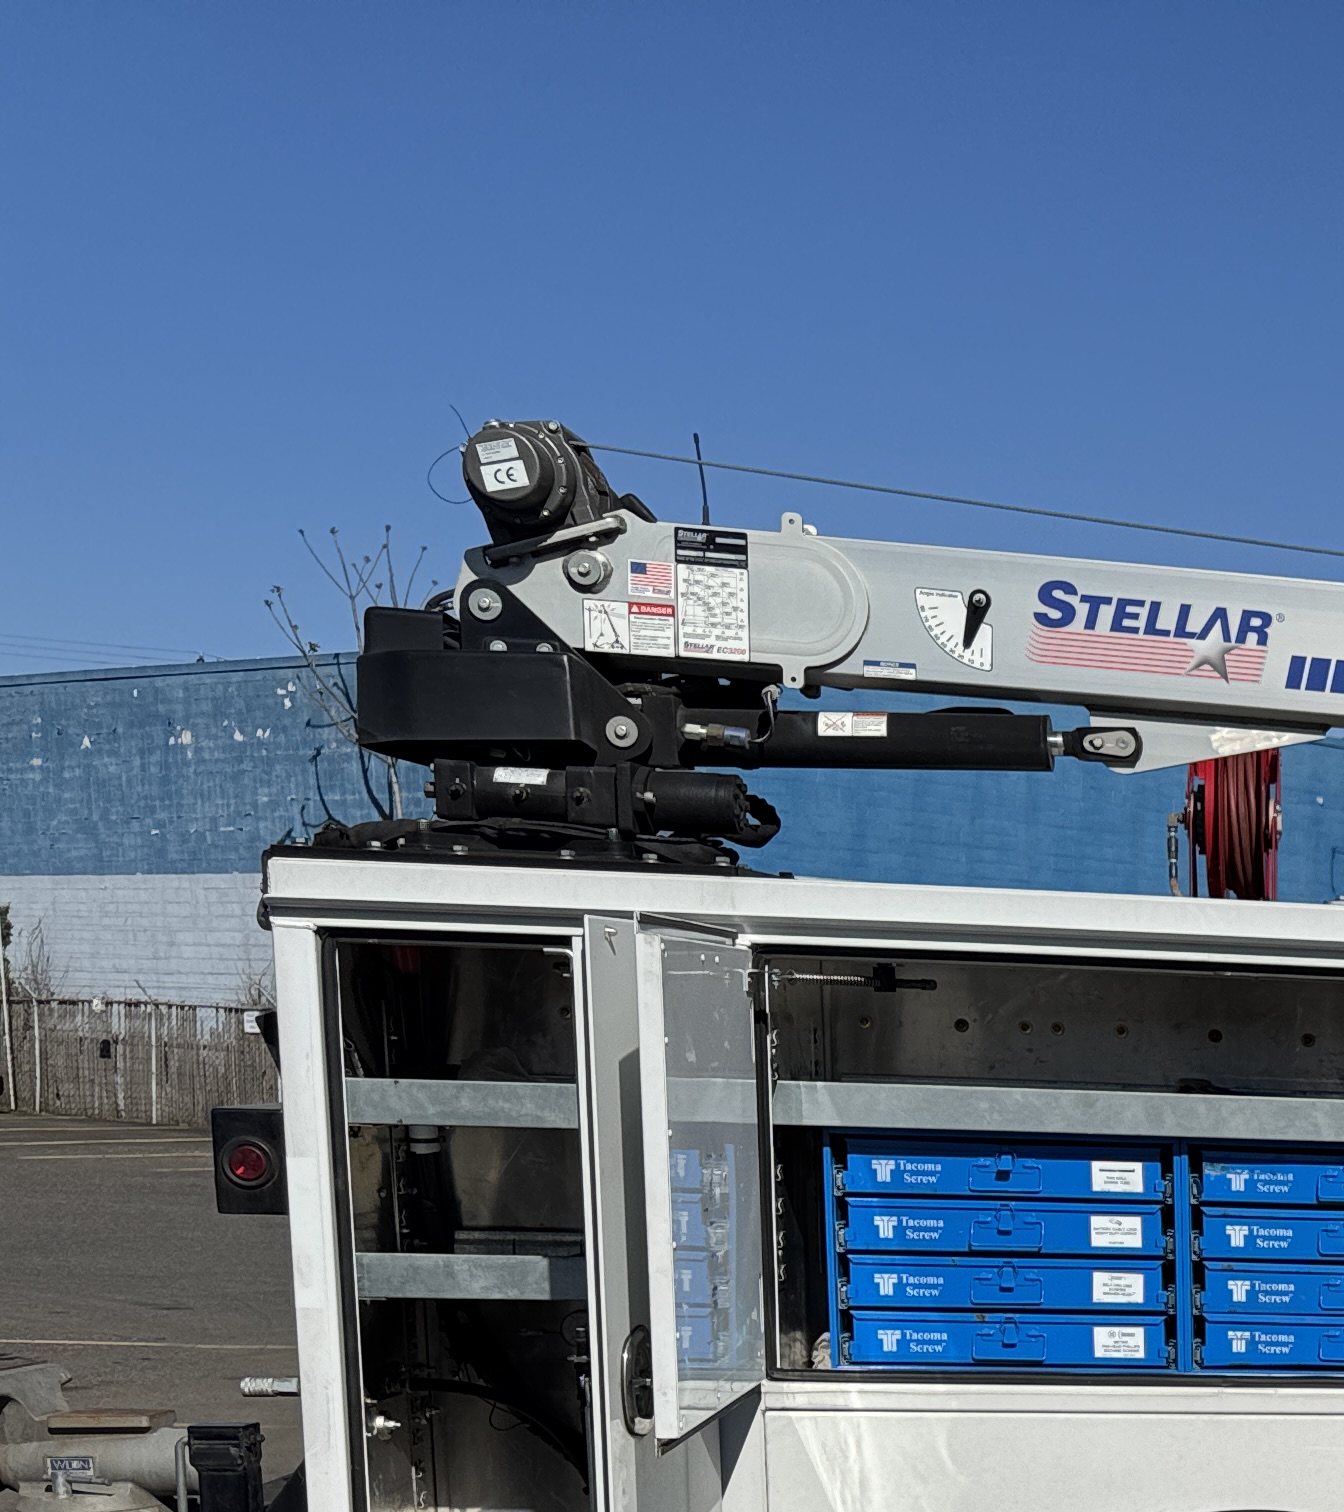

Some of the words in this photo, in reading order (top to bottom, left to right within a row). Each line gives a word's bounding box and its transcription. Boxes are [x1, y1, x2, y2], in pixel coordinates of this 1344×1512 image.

[494, 467, 518, 484] CE
[1033, 580, 1273, 646] STELLAR
[898, 1160, 942, 1171] Tacoma
[903, 1172, 938, 1183] Screw
[1256, 1182, 1290, 1193] Screw
[900, 1216, 944, 1227] Tacoma
[906, 1228, 941, 1240] Screw
[1251, 1225, 1293, 1237] Tacoma
[1256, 1238, 1289, 1249] Screw
[900, 1273, 944, 1284] Tacoma
[906, 1285, 941, 1297] Screw
[1253, 1280, 1294, 1292] Tacoma
[1258, 1292, 1291, 1304] Screw
[904, 1329, 947, 1341] Tacoma
[1253, 1331, 1294, 1342] Tacoma
[909, 1341, 944, 1353] Screw
[1258, 1343, 1291, 1354] Screw
